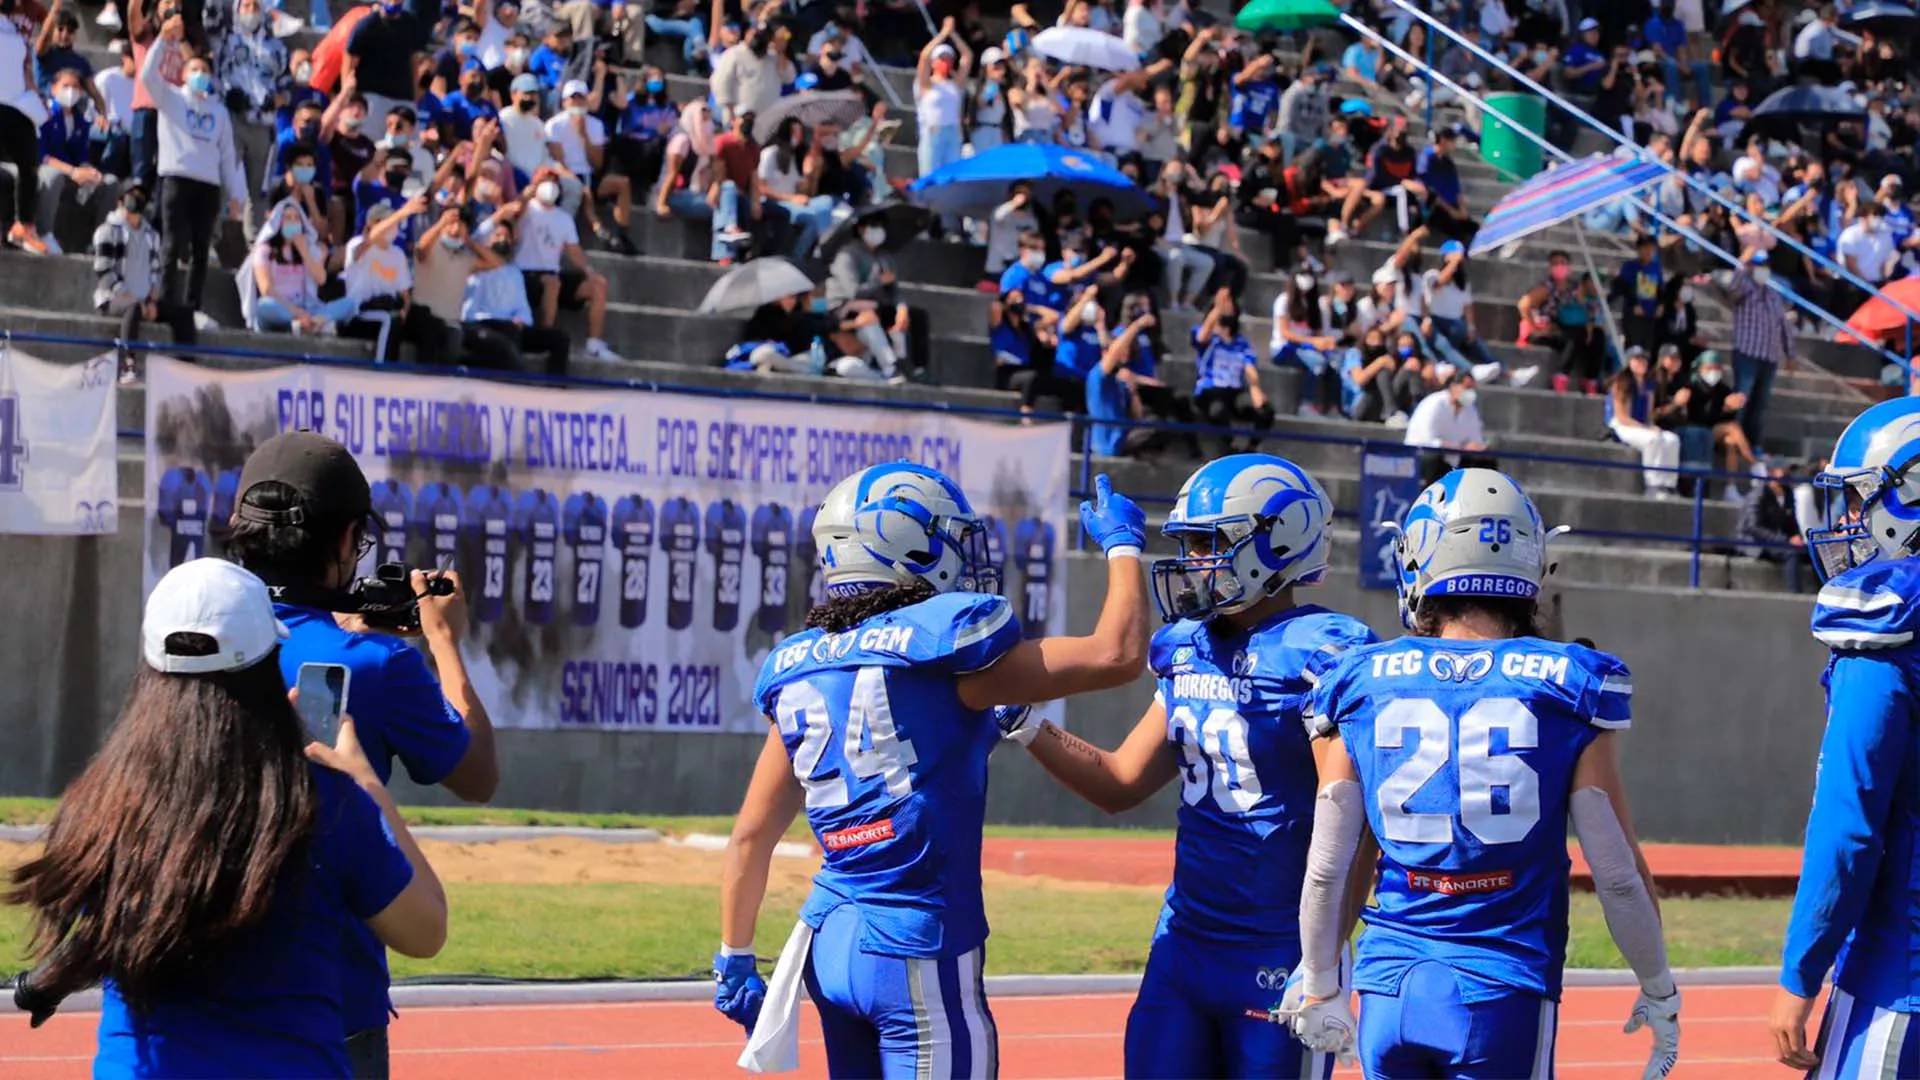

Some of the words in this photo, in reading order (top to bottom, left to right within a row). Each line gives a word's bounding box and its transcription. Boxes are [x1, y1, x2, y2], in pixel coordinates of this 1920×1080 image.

[278, 389, 325, 434] POR
[334, 393, 364, 455] SU
[373, 397, 492, 465] ESFUERZO
[500, 406, 515, 466] Y
[657, 417, 698, 478] POR
[707, 421, 798, 484] SIEMPRE
[1478, 517, 1512, 545] 26
[484, 556, 504, 599] 13
[531, 559, 553, 603] 23
[577, 561, 600, 604] 27
[1446, 577, 1534, 597] BORREGOS
[858, 626, 914, 653] CEM
[1172, 673, 1253, 705] BORREGOS
[1371, 649, 1424, 679] TEC
[1501, 652, 1569, 686] CEM
[560, 660, 658, 725] SENIORS
[667, 663, 721, 726] 2021
[775, 665, 919, 809] 24
[1167, 705, 1263, 813] 30
[1374, 697, 1541, 846] 26
[840, 825, 889, 845] BANORTE
[1433, 876, 1509, 891] BANORTE
